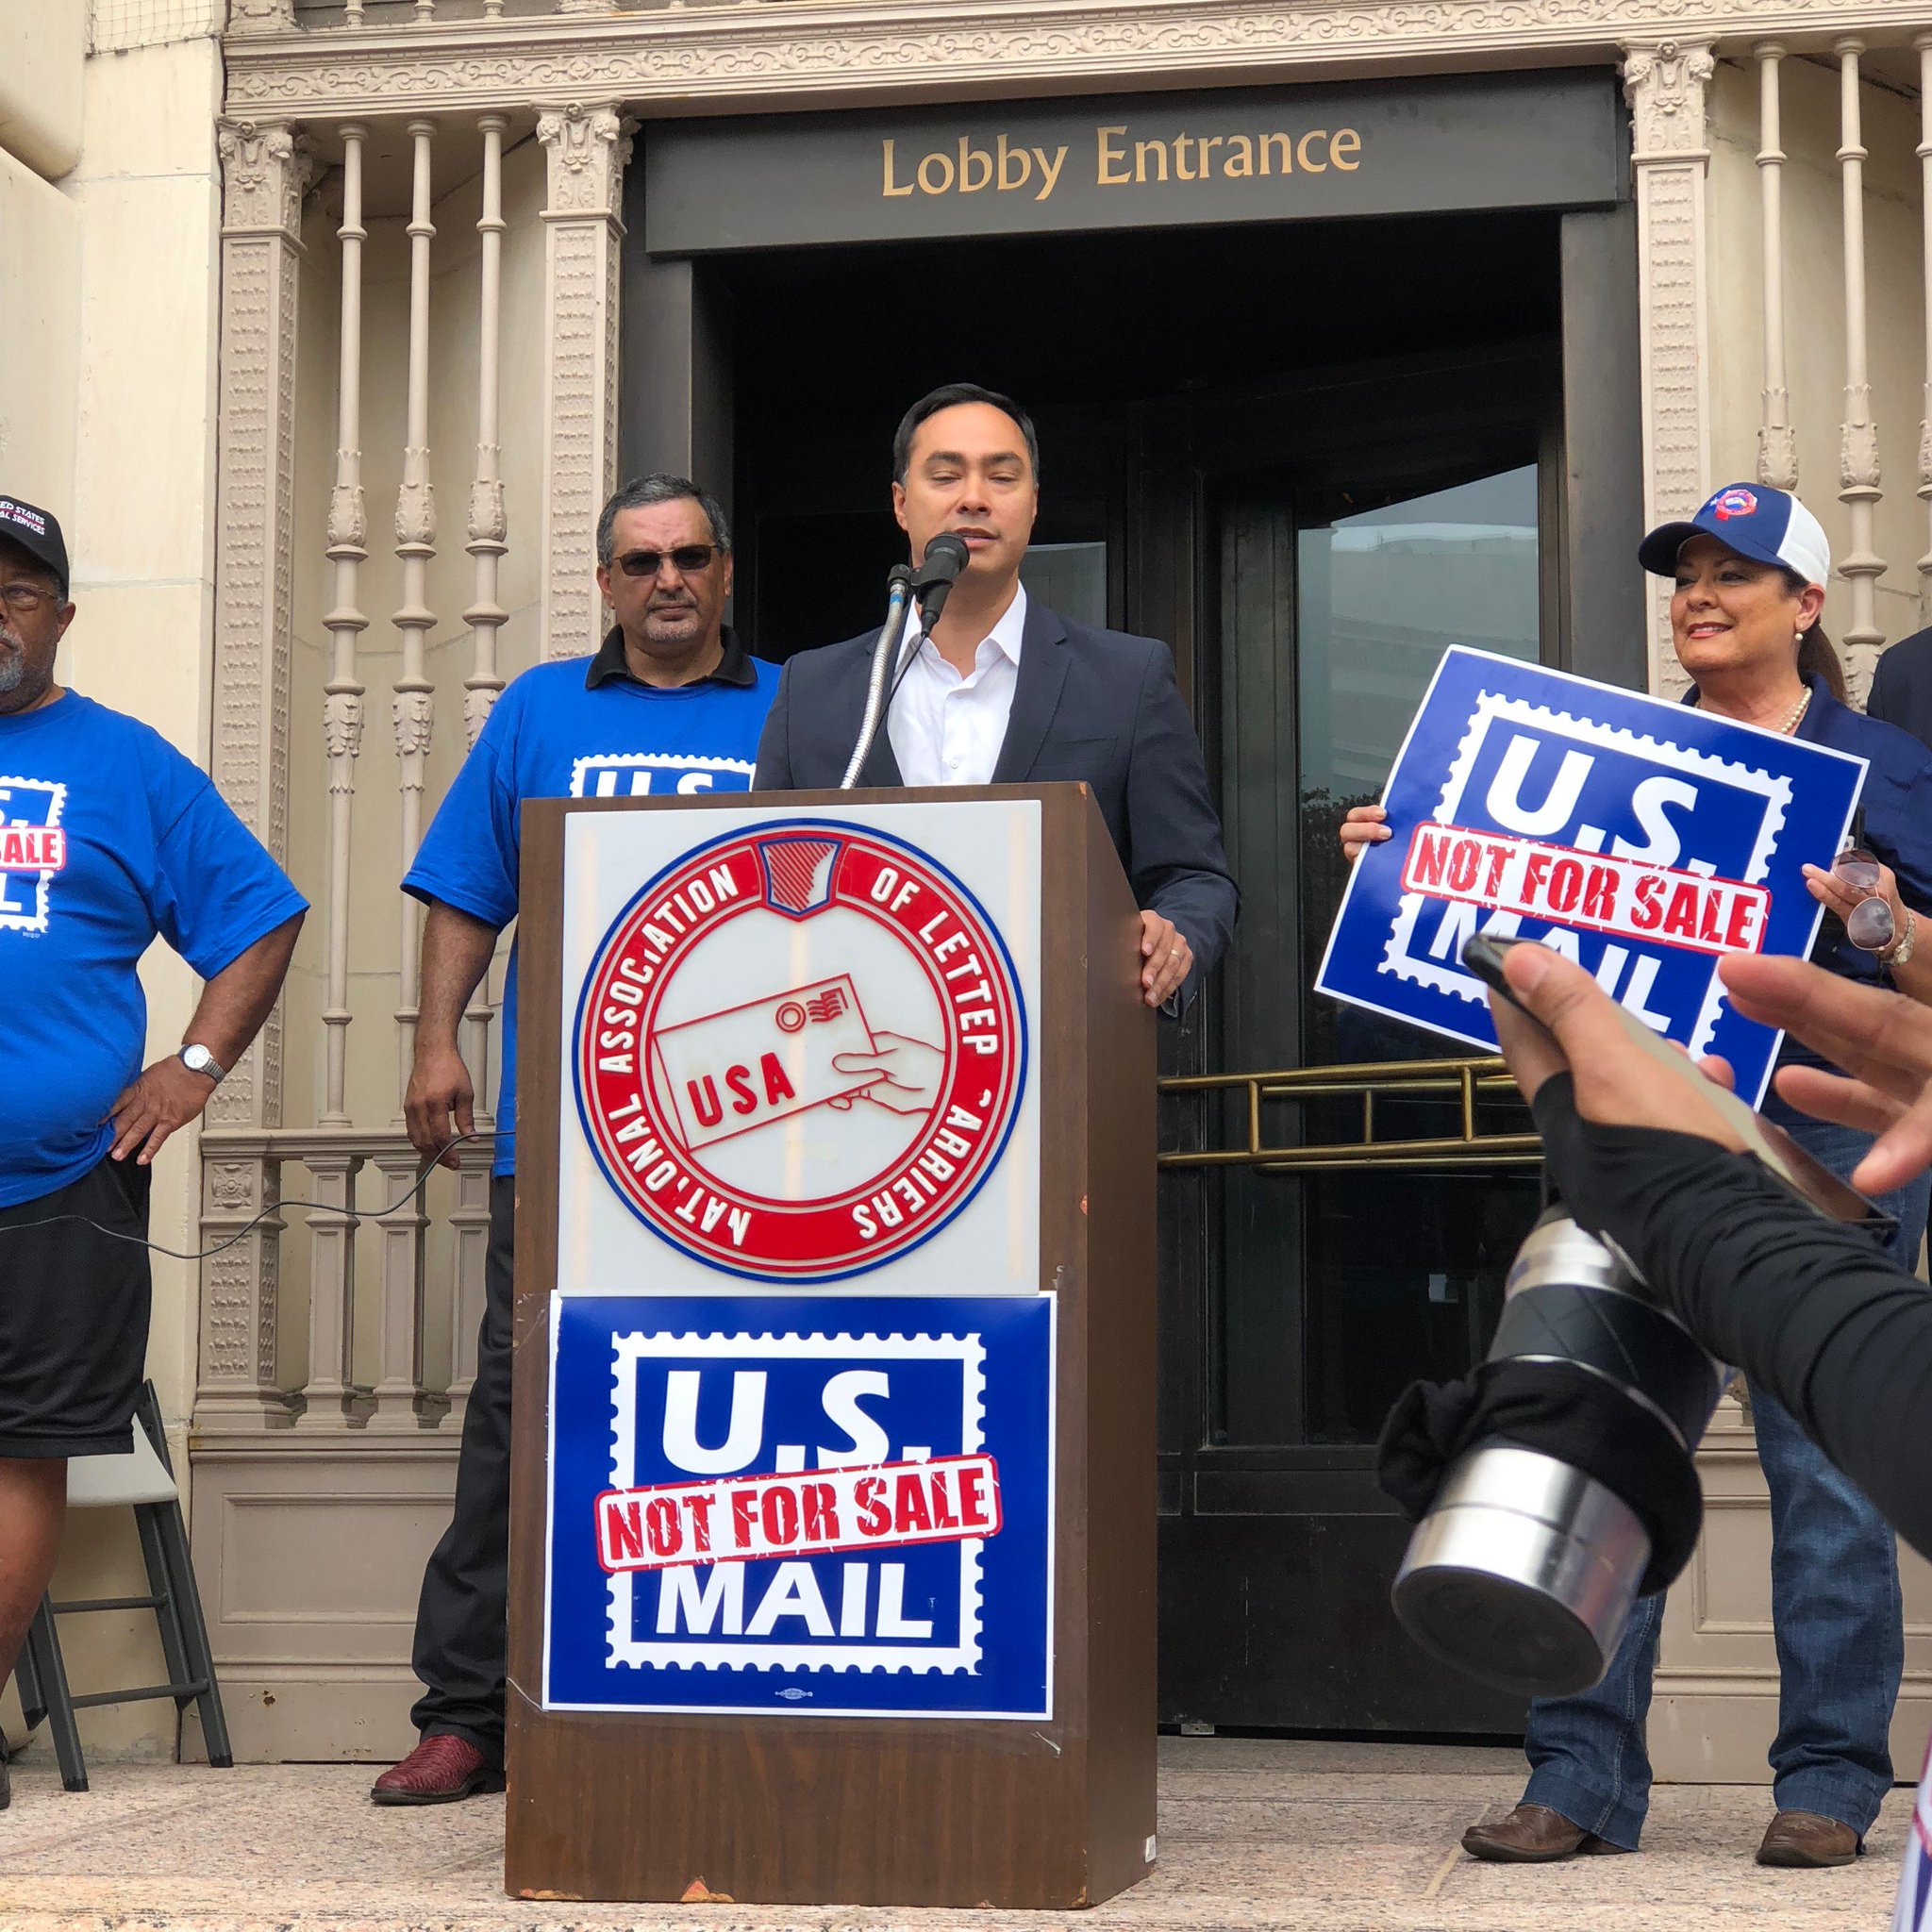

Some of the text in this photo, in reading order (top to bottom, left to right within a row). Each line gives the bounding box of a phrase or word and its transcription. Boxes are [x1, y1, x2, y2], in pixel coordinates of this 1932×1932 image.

[882, 125, 1361, 200] Lobby Entrance
[12, 514, 45, 535] SERVICES
[15, 506, 45, 525] STATES
[1486, 734, 1717, 876] U.S.
[0, 833, 58, 863] ALE
[870, 867, 921, 912] OF
[1412, 833, 1760, 949] NOT FOR SALE
[687, 1052, 795, 1127] USA
[662, 1370, 932, 1474] U.S.
[607, 1467, 989, 1560] NOT FOR SALE
[656, 1561, 933, 1639] MAIL
